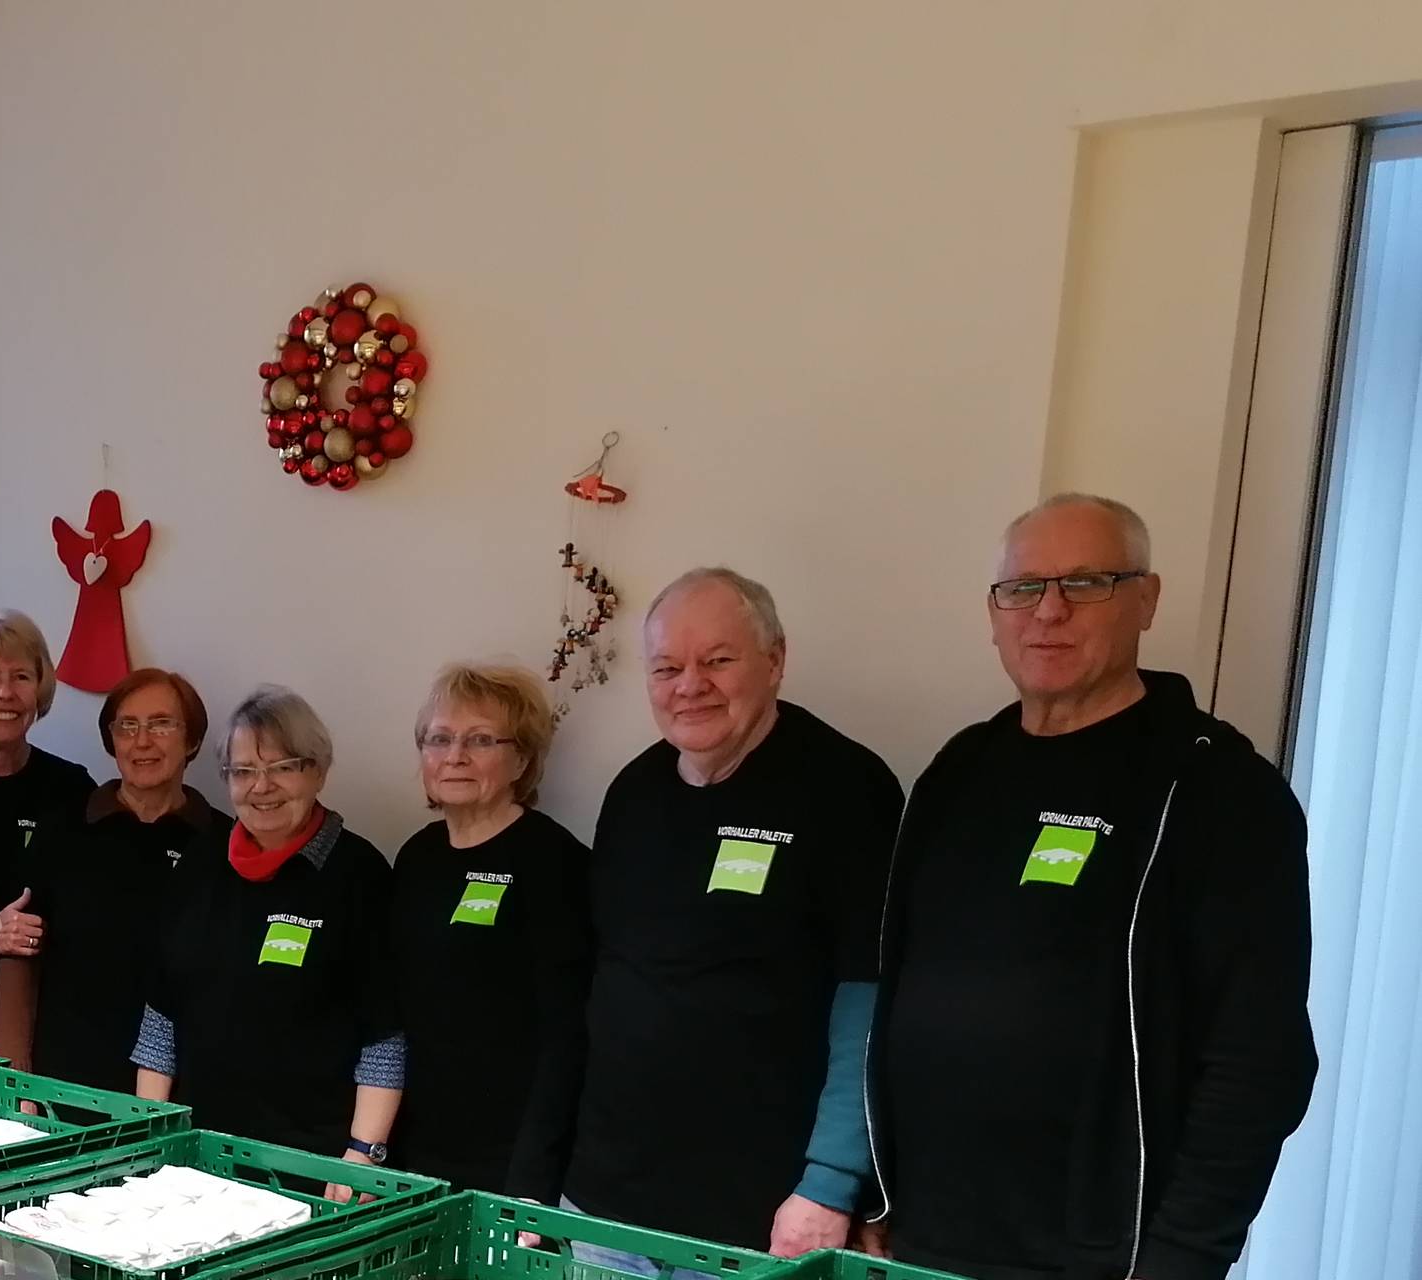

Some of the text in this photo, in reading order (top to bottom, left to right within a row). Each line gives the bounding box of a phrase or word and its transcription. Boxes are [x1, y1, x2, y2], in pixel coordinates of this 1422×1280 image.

[1039, 811, 1114, 836] VORHALLER PALETTE
[718, 826, 794, 844] VORHALLER PALETTE
[267, 913, 324, 928] VORHALLER PALETTE
